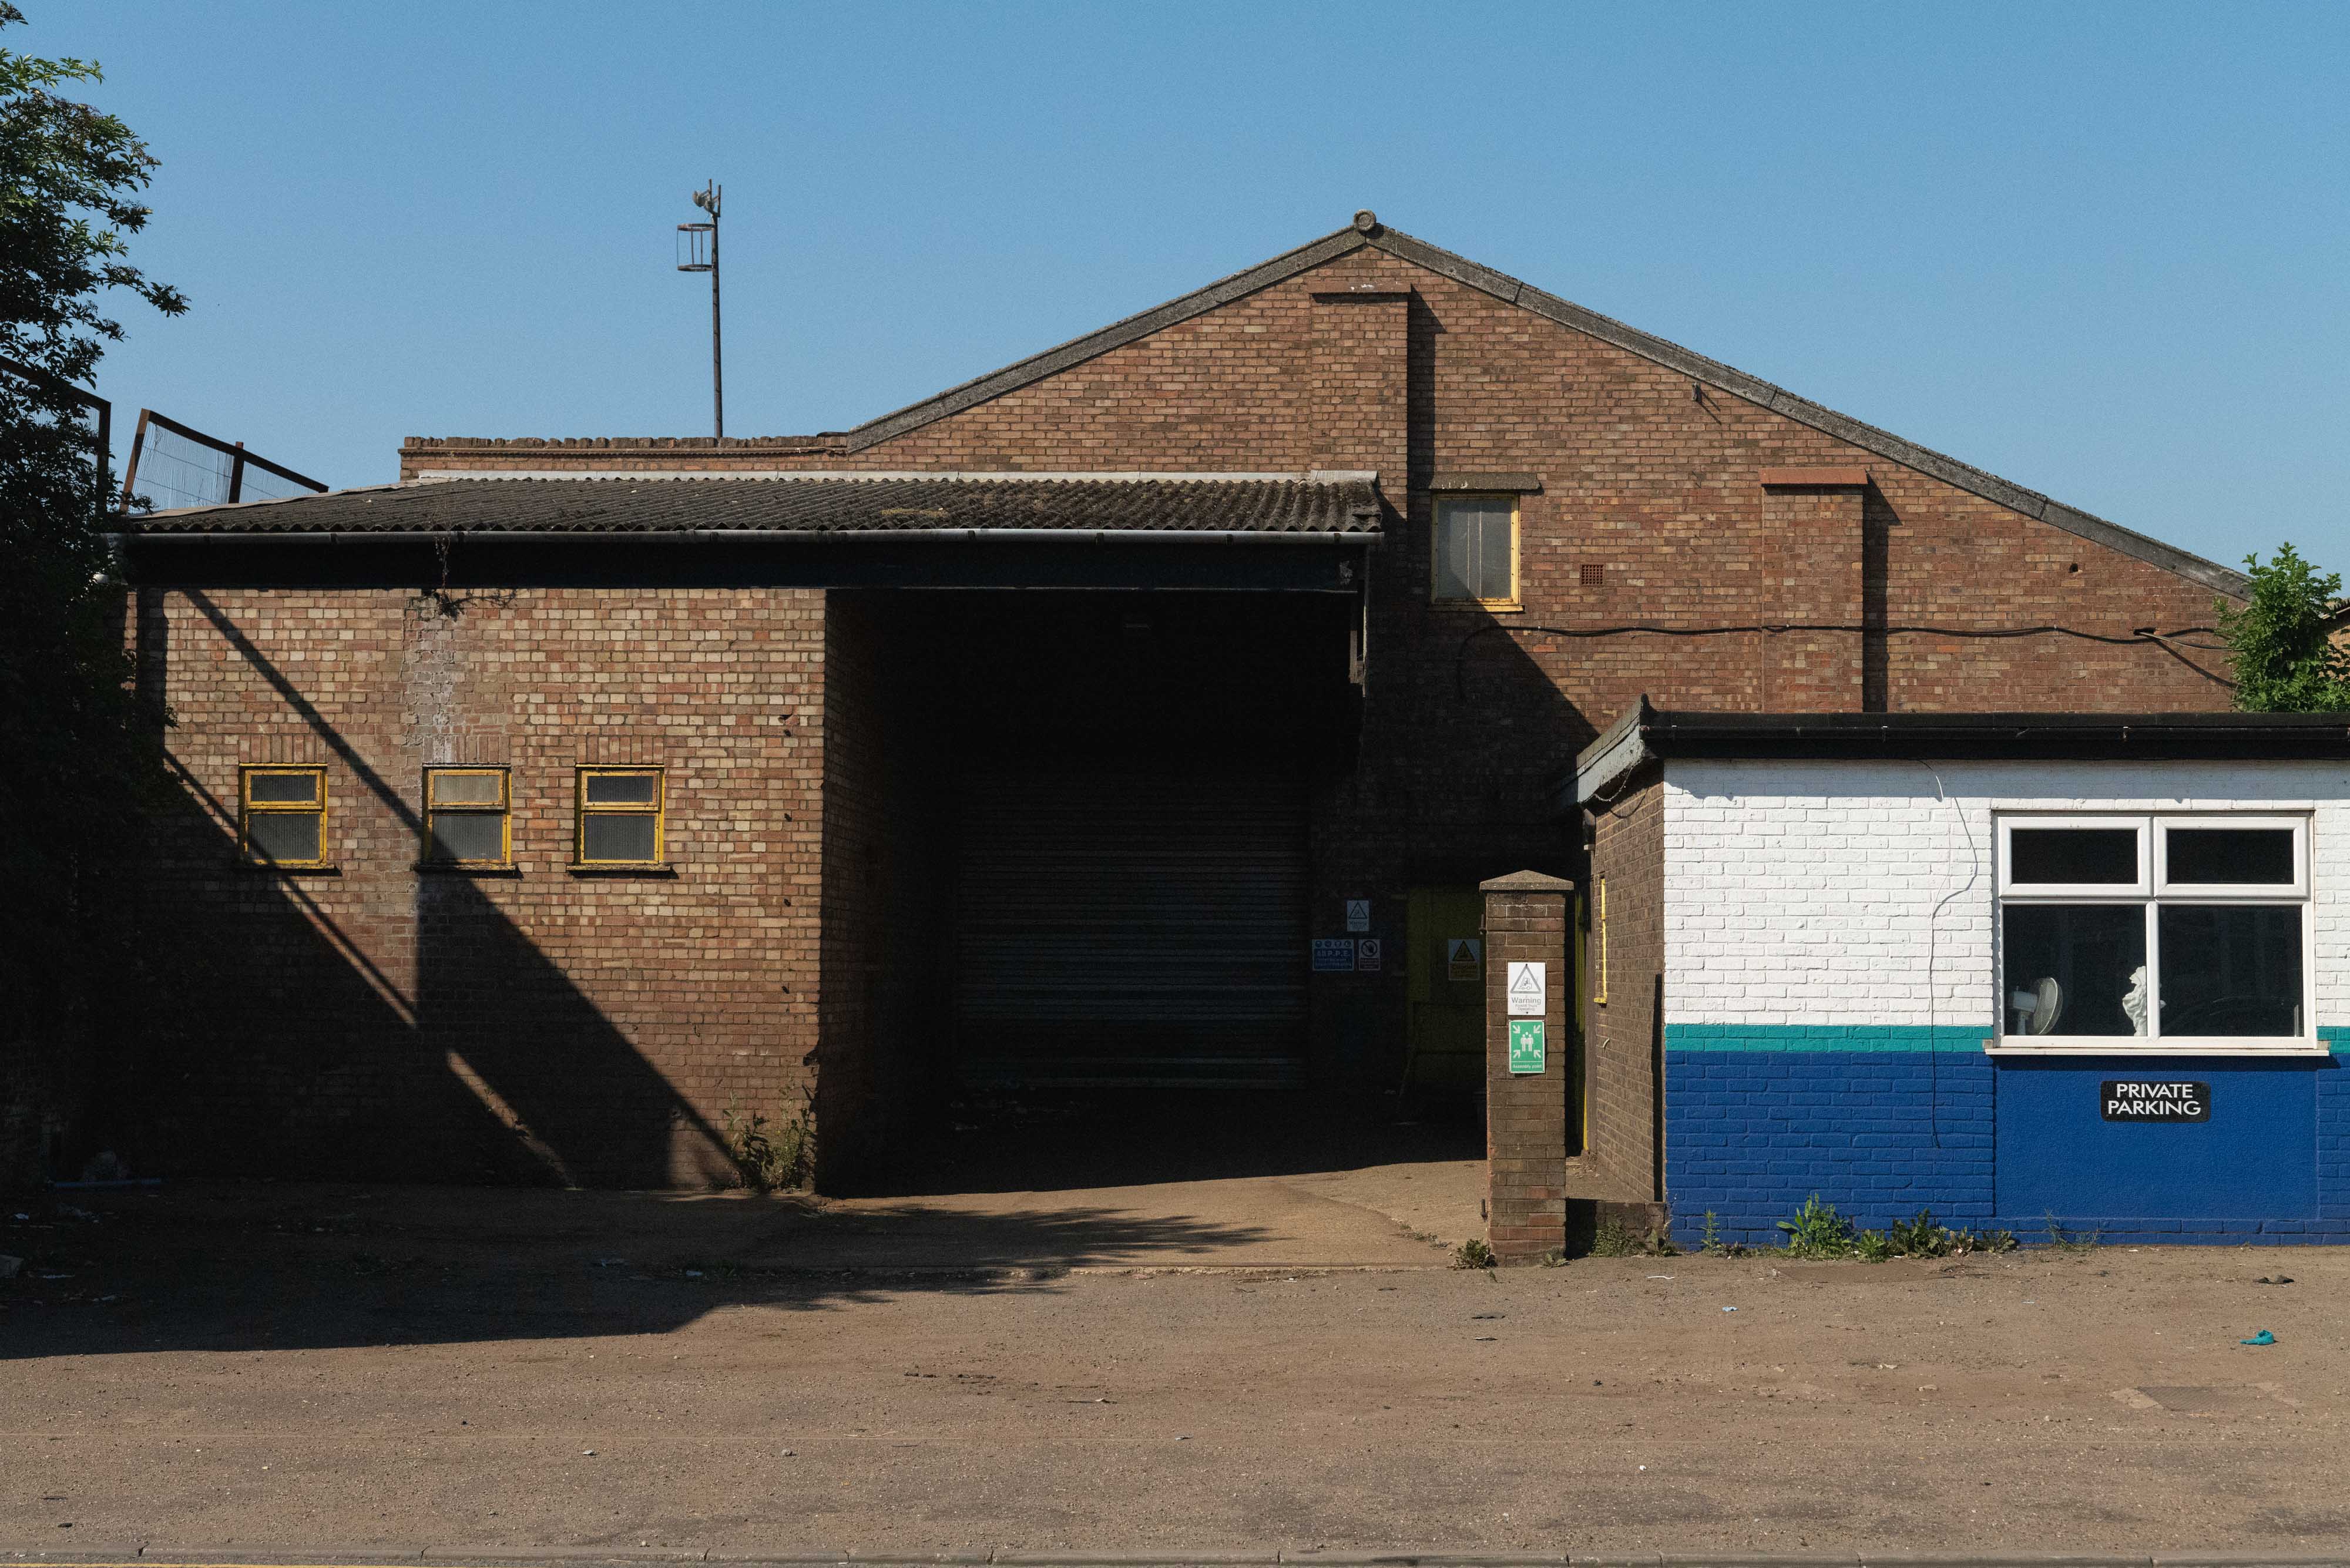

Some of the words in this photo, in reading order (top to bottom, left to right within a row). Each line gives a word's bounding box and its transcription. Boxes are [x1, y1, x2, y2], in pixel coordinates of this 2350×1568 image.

[1512, 997, 1542, 1005] Warning
[2117, 1084, 2193, 1098] PRIVATE
[2108, 1100, 2201, 1115] PARKING
